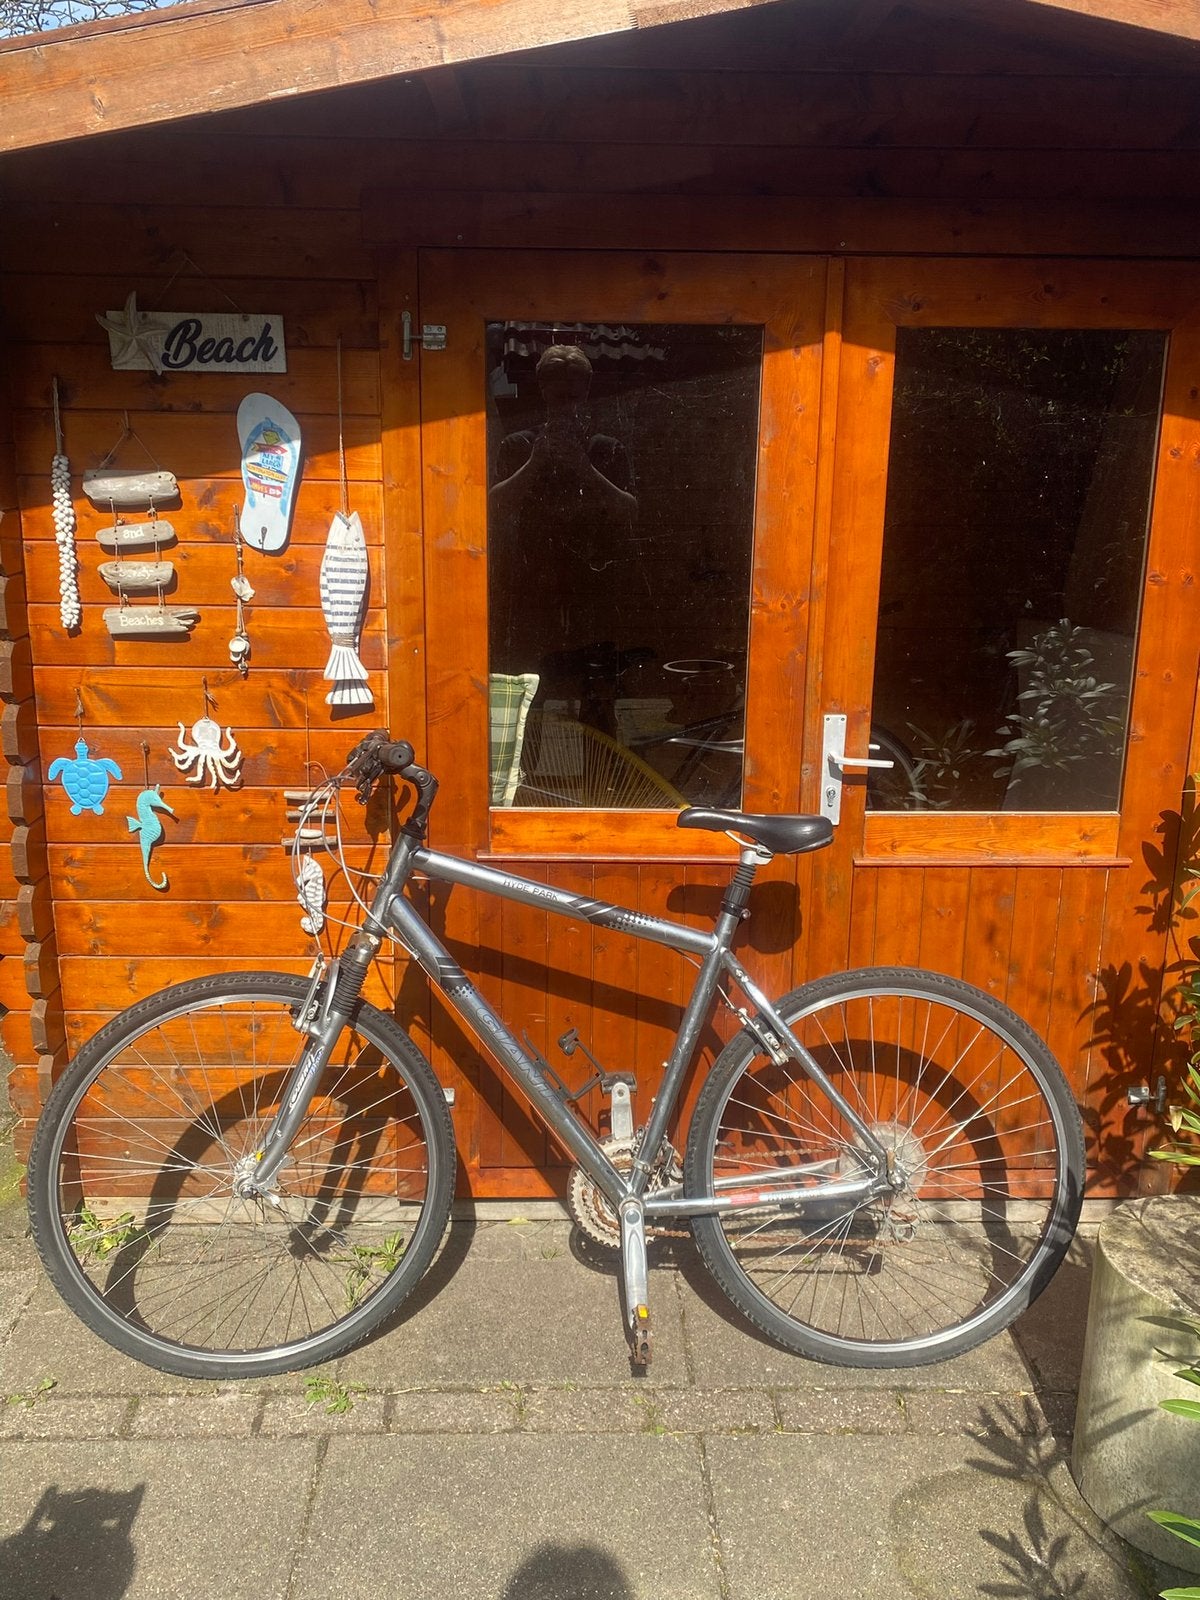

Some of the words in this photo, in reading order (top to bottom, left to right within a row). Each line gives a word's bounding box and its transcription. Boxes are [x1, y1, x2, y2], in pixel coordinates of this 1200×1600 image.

[161, 318, 278, 369] Beach
[122, 526, 145, 540] and
[119, 614, 165, 628] Beaches
[503, 879, 530, 894] HYDE
[532, 887, 560, 903] PARK
[476, 1007, 560, 1105] GIANT
